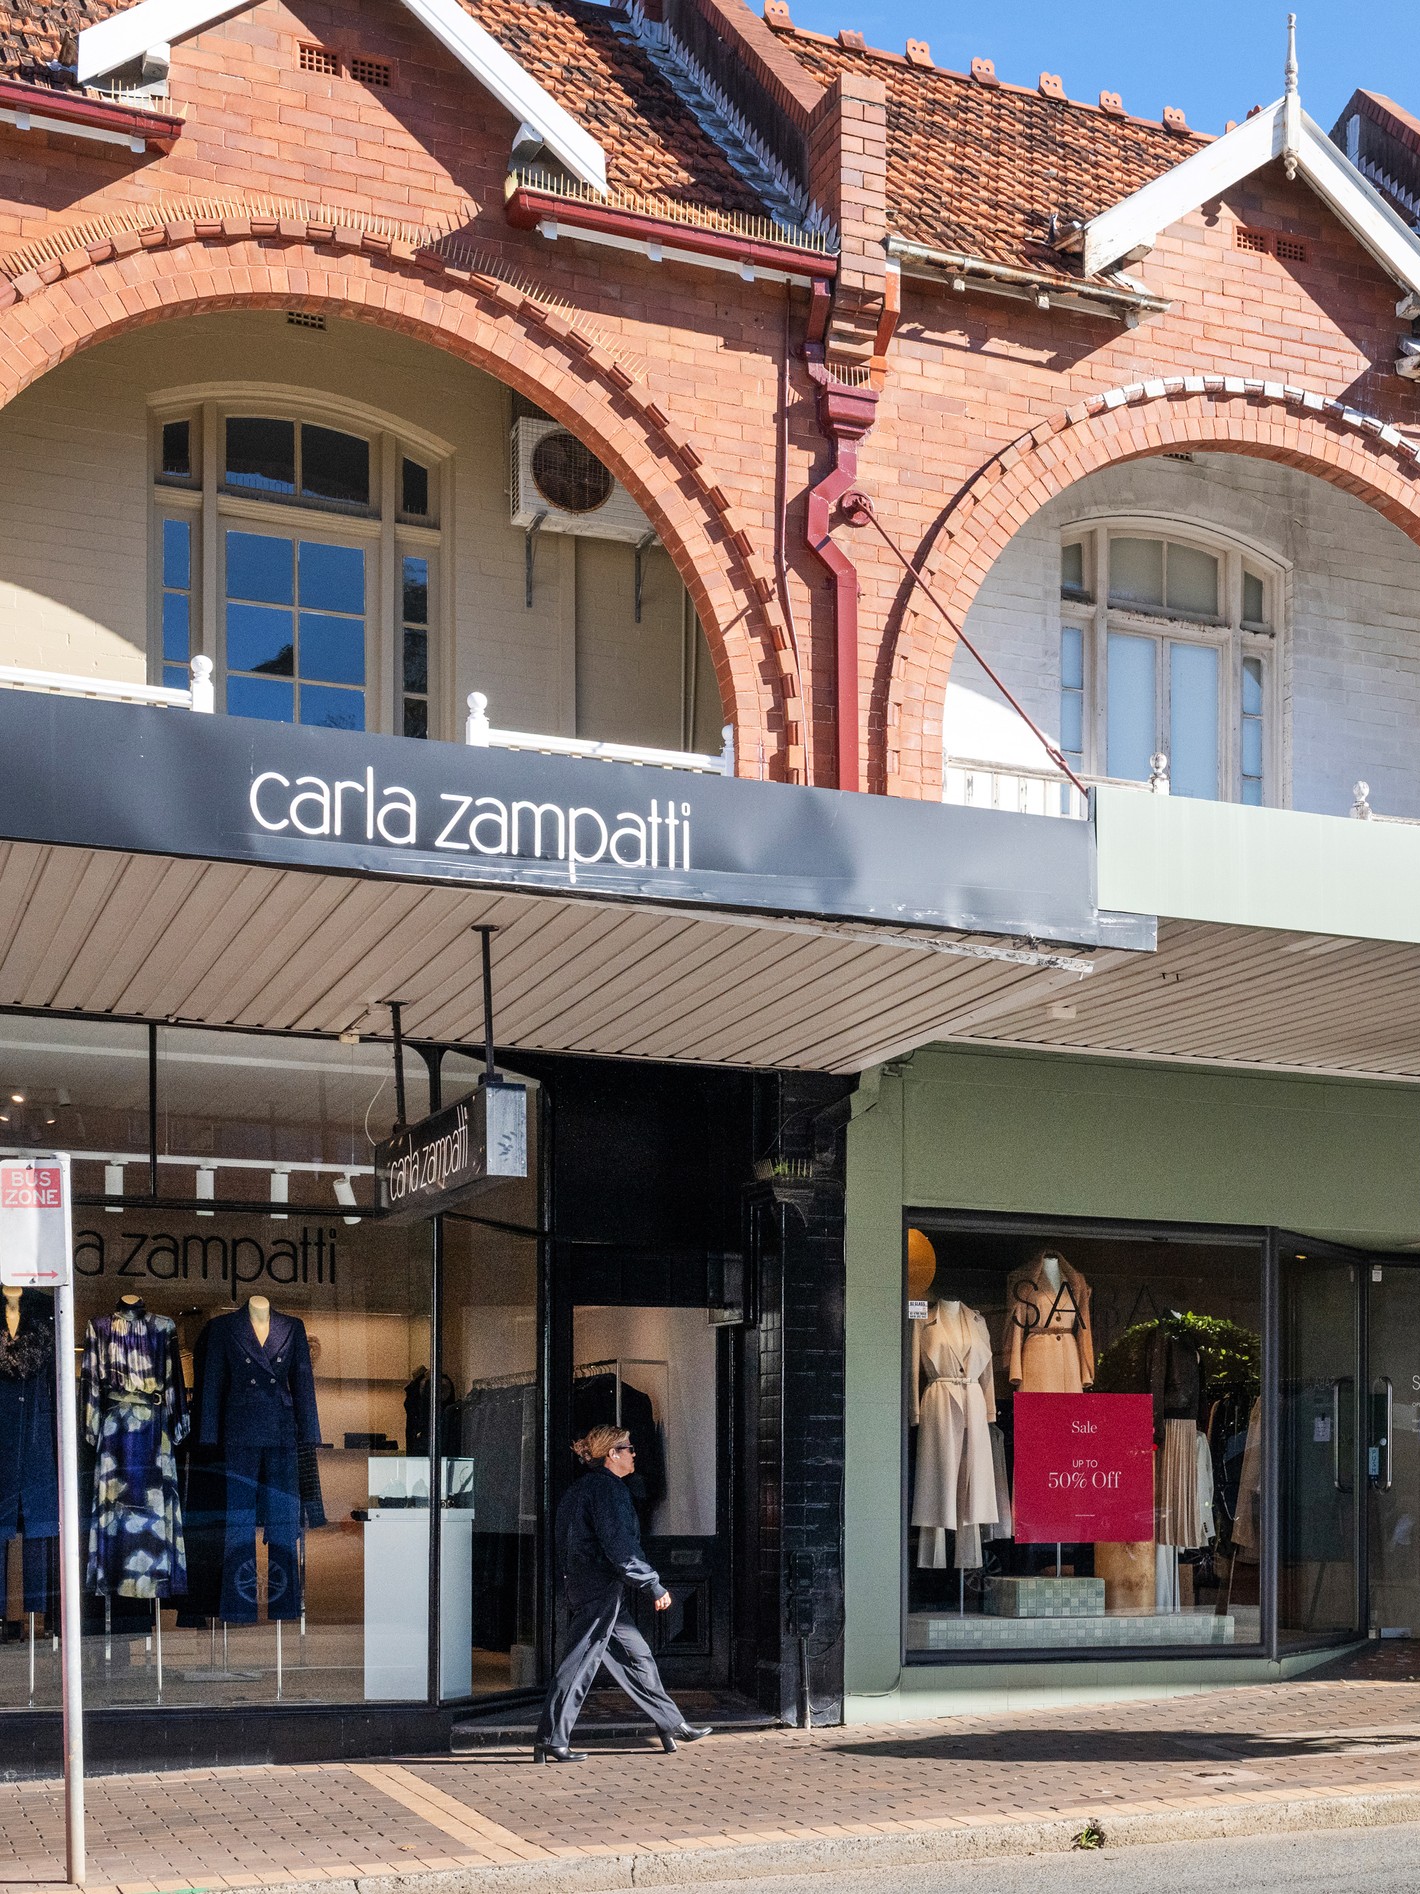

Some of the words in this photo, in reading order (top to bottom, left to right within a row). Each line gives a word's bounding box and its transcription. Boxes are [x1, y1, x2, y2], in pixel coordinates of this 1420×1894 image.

[249, 765, 417, 845] carla
[434, 793, 691, 884] zampatti
[389, 1133, 420, 1202] carla
[420, 1104, 469, 1190] zampatti
[11, 1171, 52, 1187] BUS
[5, 1189, 59, 1205] ZONE
[117, 1226, 338, 1303] zampatti
[1071, 1420, 1098, 1434] Sale
[1072, 1459, 1084, 1468] UP
[1086, 1459, 1098, 1468] TO
[1048, 1472, 1087, 1489] 50%
[1091, 1471, 1122, 1489] Off
